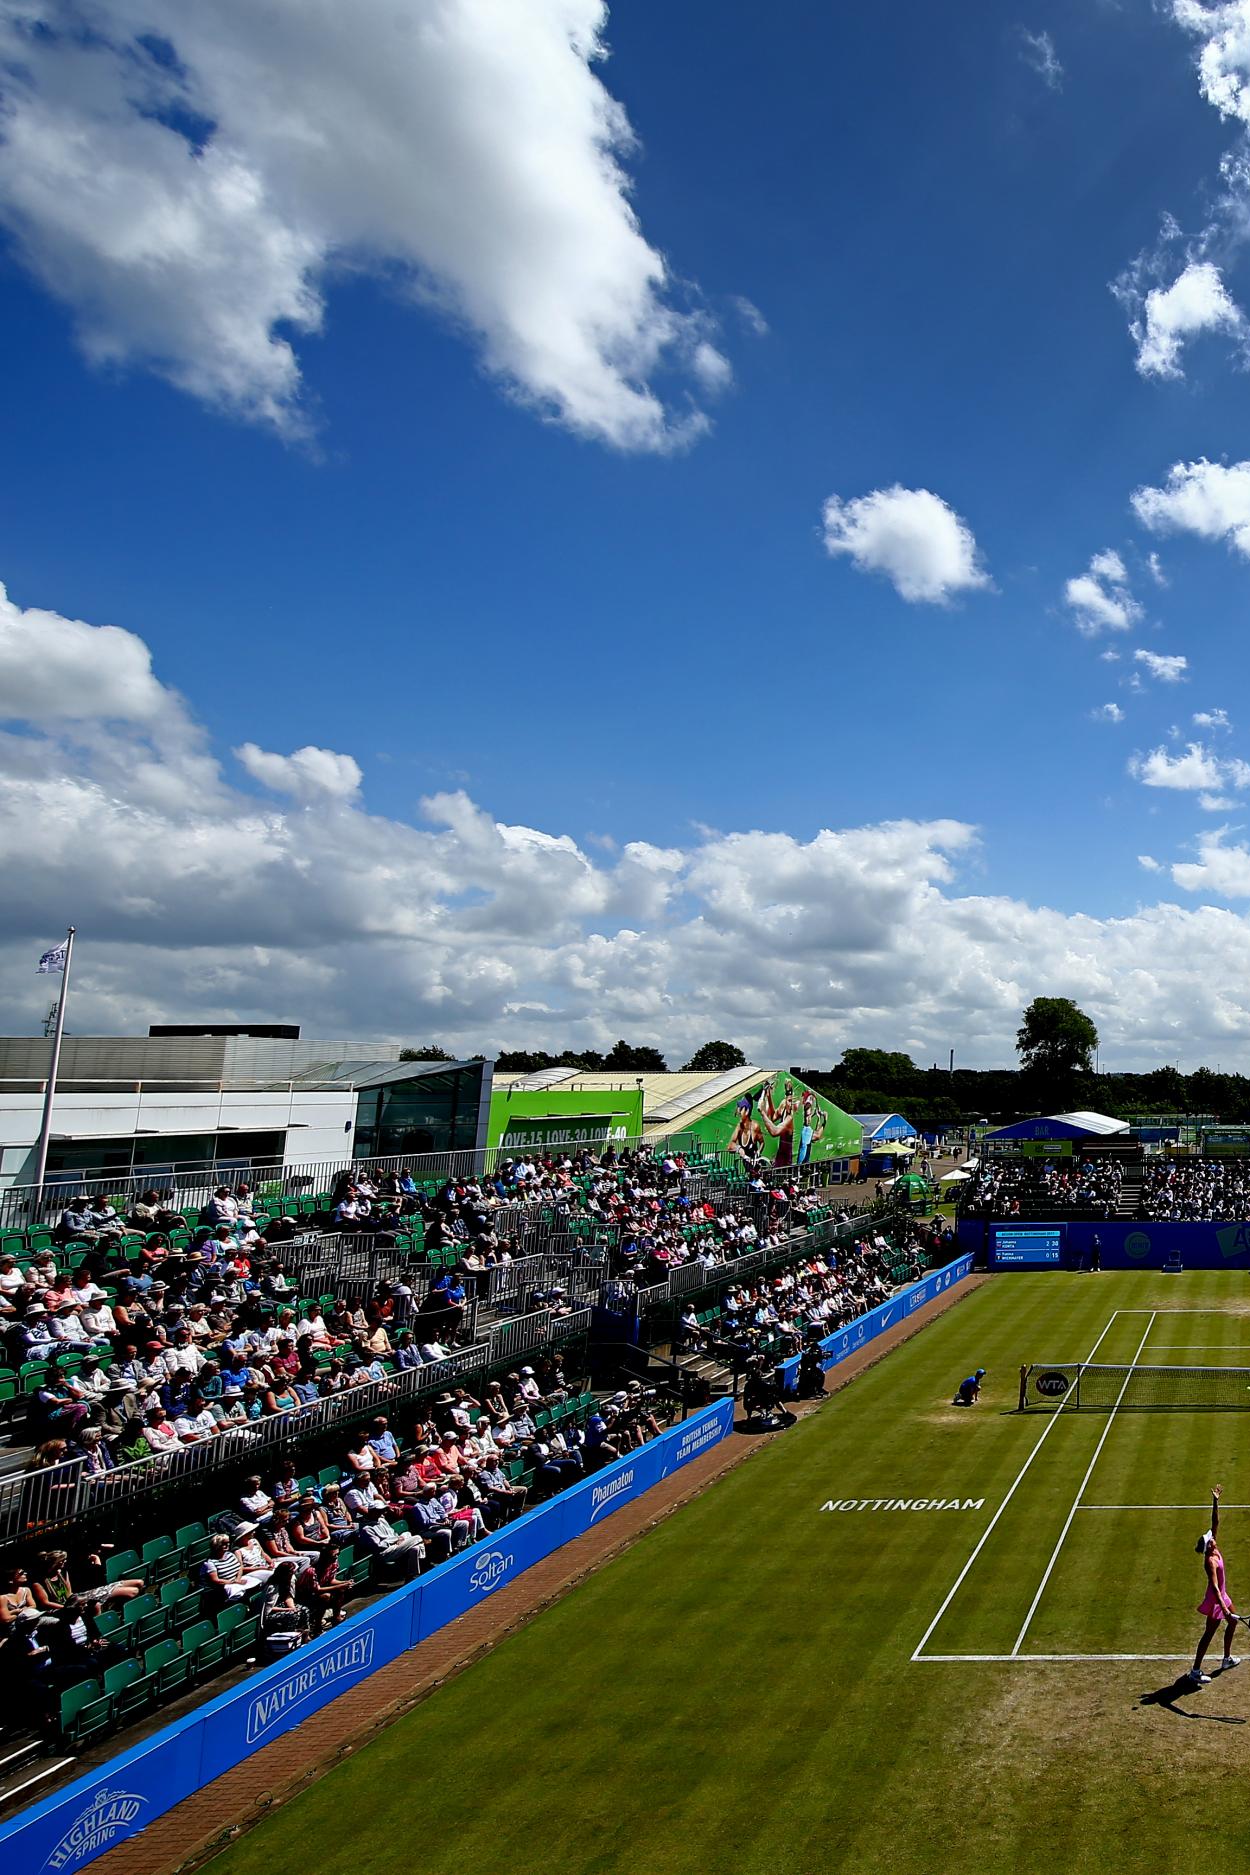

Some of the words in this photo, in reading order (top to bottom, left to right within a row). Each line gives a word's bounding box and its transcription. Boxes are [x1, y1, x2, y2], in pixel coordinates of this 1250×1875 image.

[1035, 1125, 1049, 1136] BAR
[1038, 1380, 1066, 1390] WTA
[676, 1444, 691, 1461] TEAM
[691, 1425, 722, 1451] MEMBERSHIP
[682, 1427, 702, 1447] BRITISH
[702, 1416, 718, 1434] TENNIS
[591, 1469, 634, 1506] Pharmaton
[819, 1498, 985, 1511] NOTTINGHAM
[469, 1554, 513, 1592] Soltan
[253, 1667, 318, 1735] NATURE
[319, 1633, 370, 1679] VALLEY
[48, 1800, 140, 1869] HIGHLAND
[75, 1826, 116, 1860] SPRING
